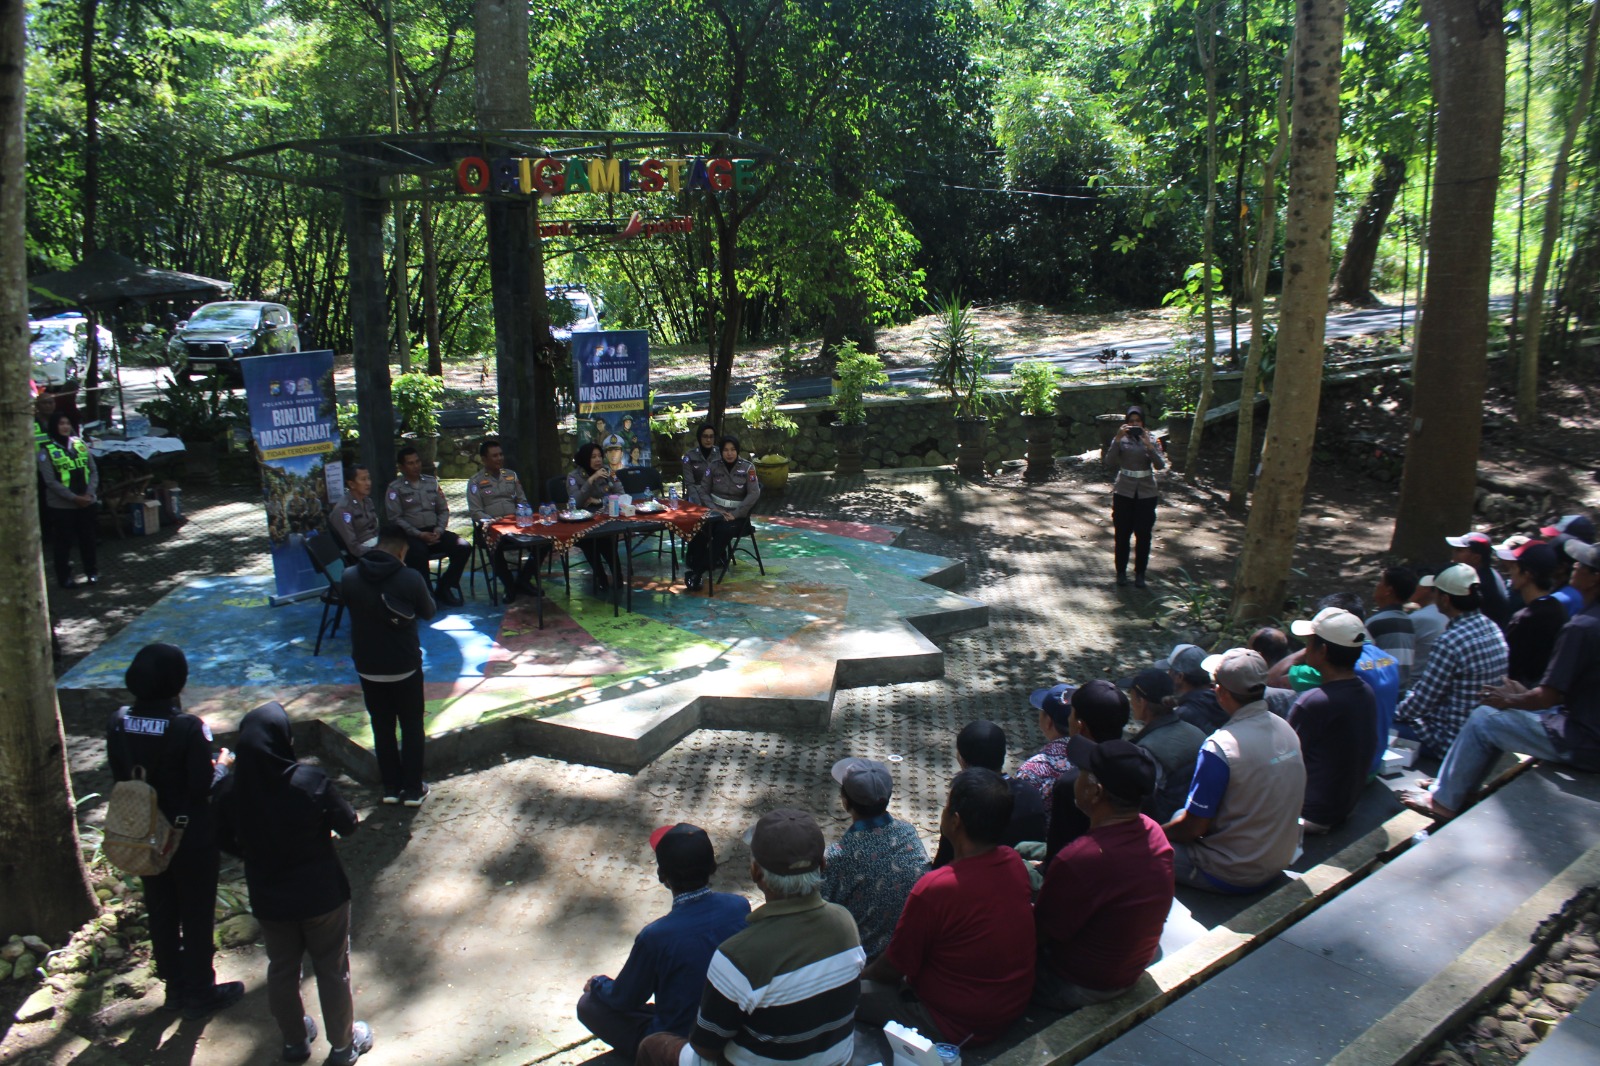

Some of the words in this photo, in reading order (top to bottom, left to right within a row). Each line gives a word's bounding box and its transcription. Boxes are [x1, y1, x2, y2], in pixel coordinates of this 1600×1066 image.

[458, 155, 631, 194] ORIGAMI
[639, 157, 756, 193] STAGE
[593, 368, 627, 383] BINLUH
[579, 384, 643, 401] MASYARAKAT
[272, 406, 316, 427] BINLUH
[260, 423, 331, 447] MASYARAKAT
[288, 444, 331, 454] TERORGANISIR
